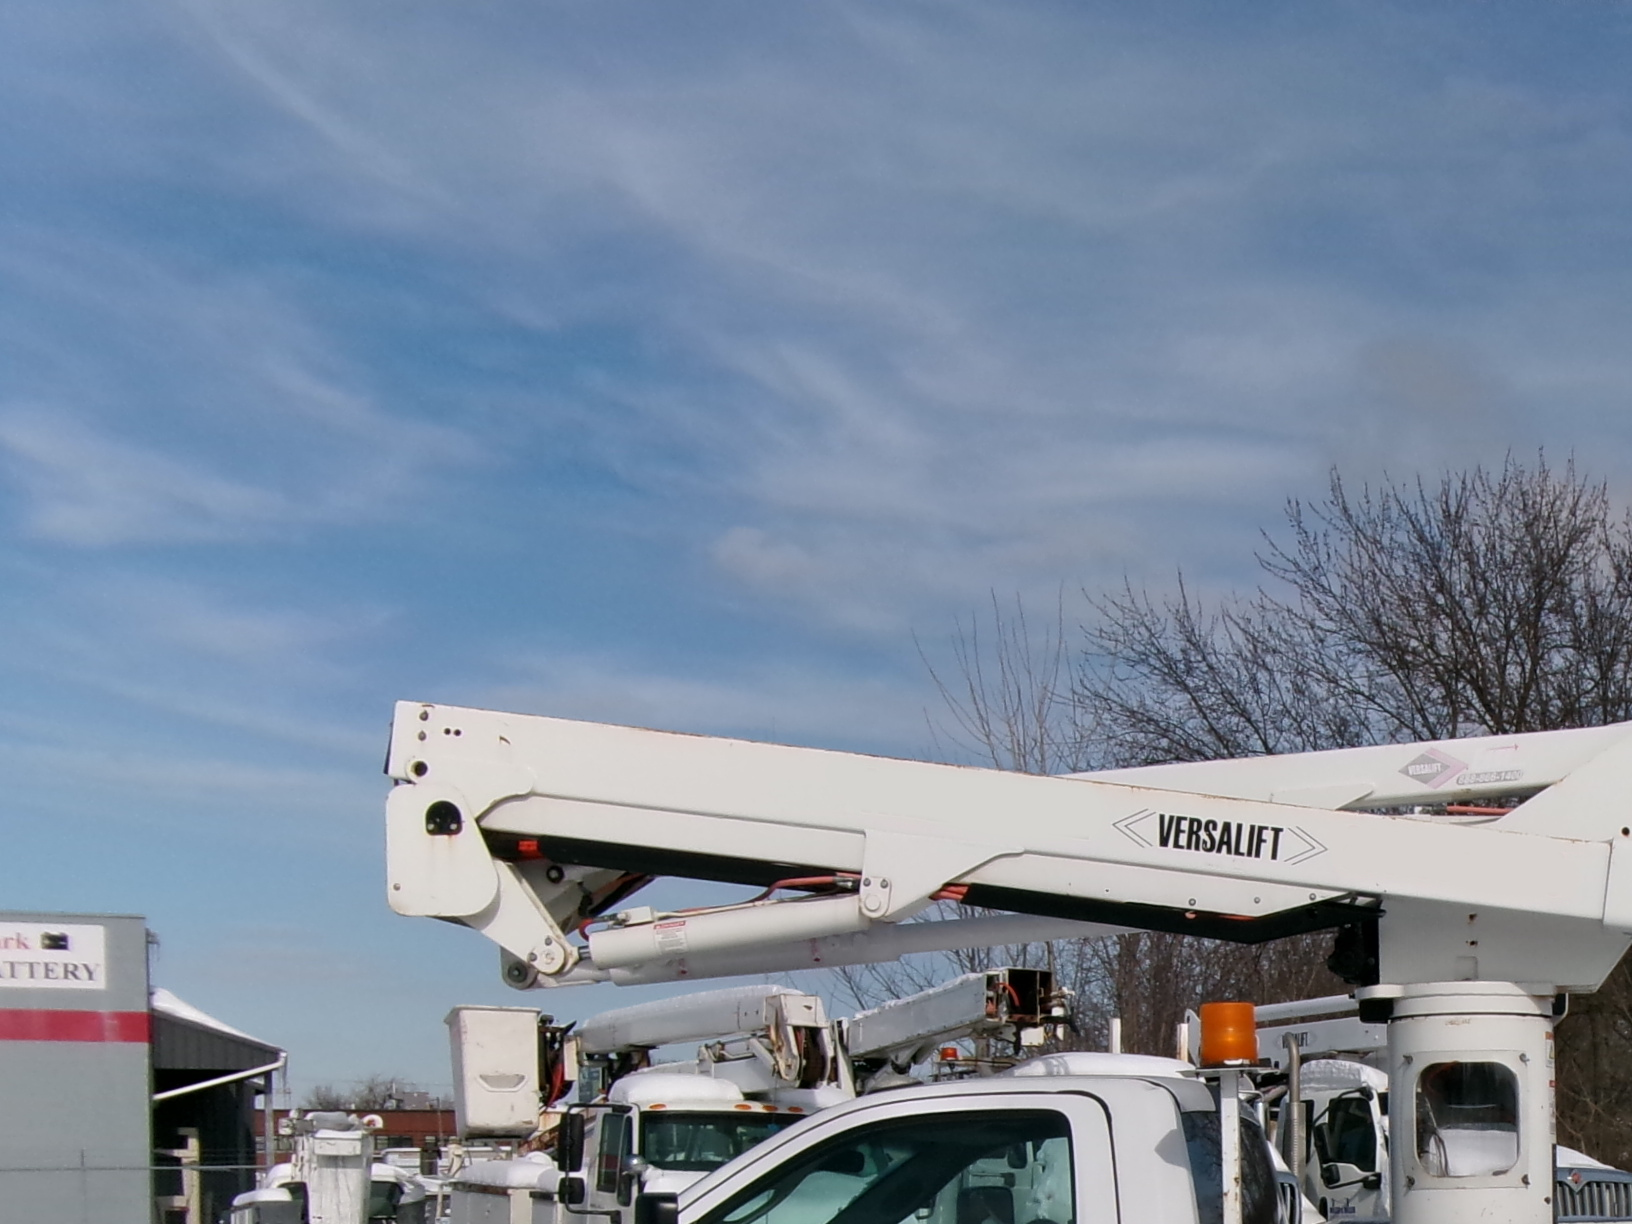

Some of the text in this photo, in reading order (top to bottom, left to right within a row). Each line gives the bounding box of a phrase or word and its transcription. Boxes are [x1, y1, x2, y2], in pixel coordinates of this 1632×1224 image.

[1407, 763, 1442, 776] VERSALIFT
[1159, 813, 1284, 861] VERSALIFT
[0, 961, 100, 981] TTERY
